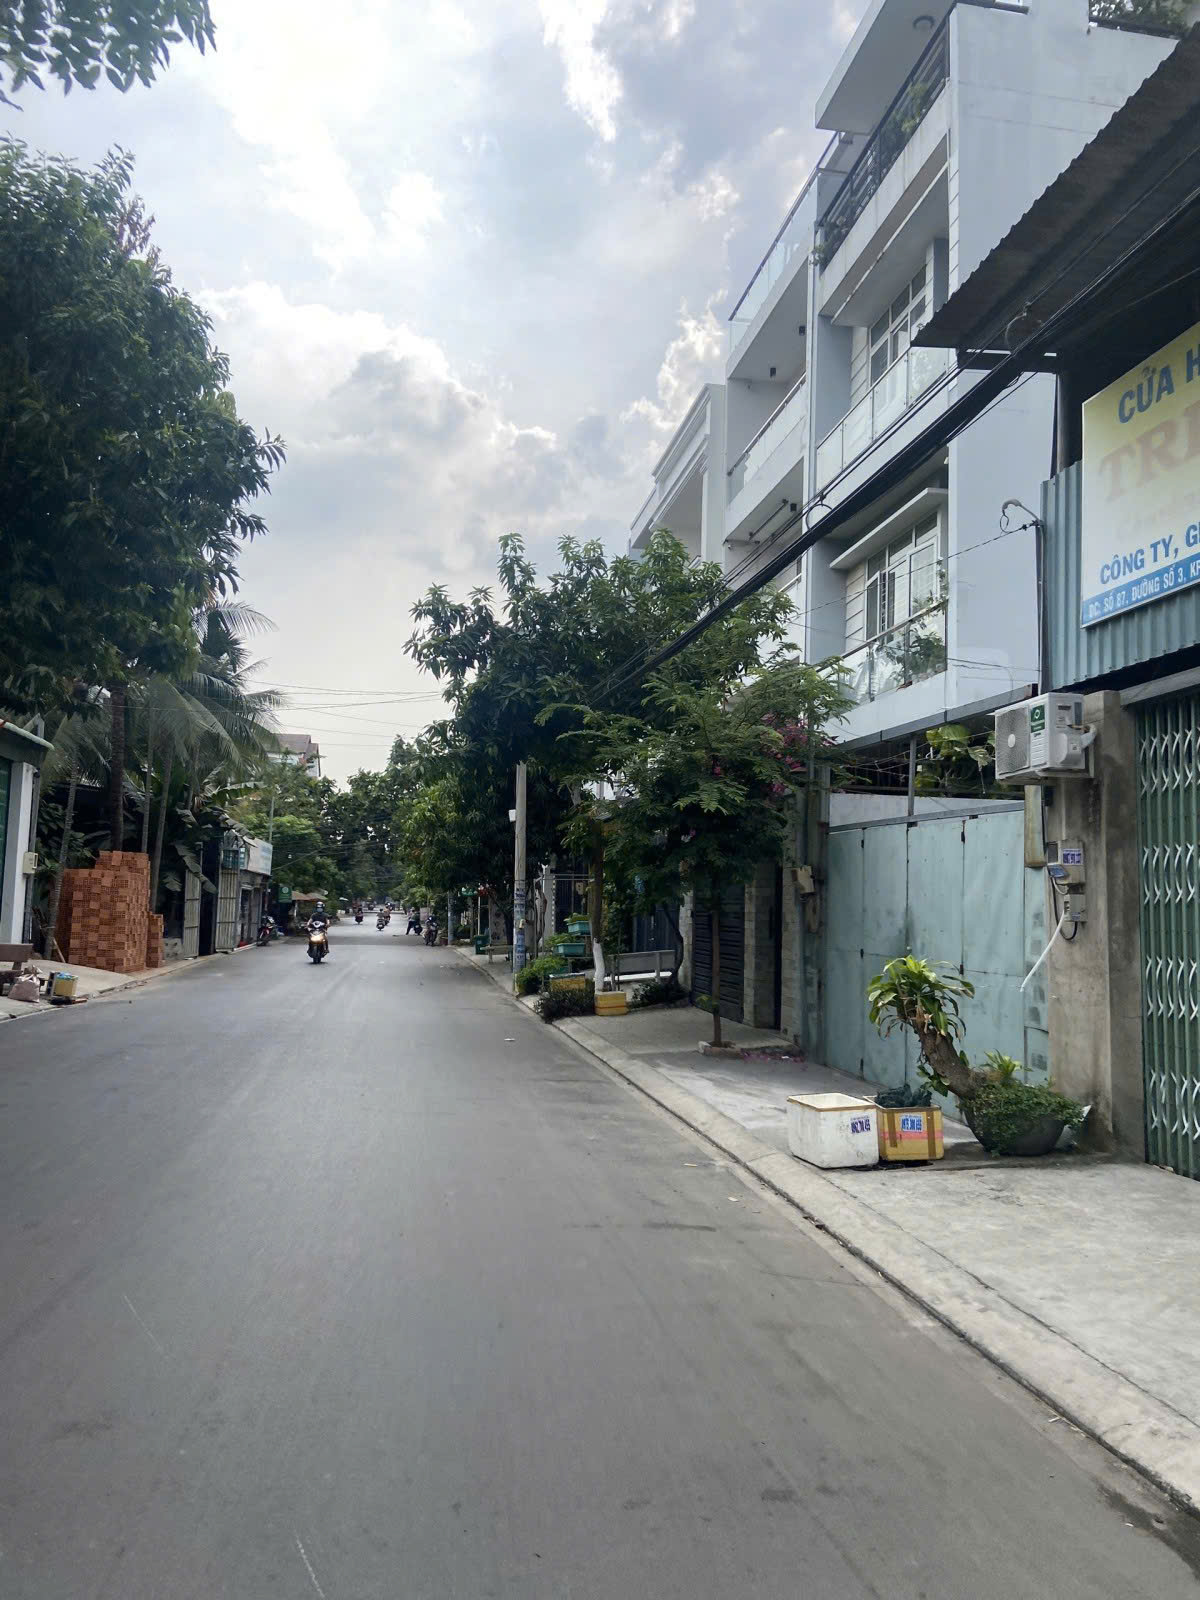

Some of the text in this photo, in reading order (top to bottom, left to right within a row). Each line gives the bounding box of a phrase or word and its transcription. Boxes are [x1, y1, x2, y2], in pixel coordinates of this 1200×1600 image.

[1119, 365, 1174, 423] CỬA
[1100, 522, 1200, 585] CÔNG TY, G
[1163, 564, 1176, 589] SỐ
